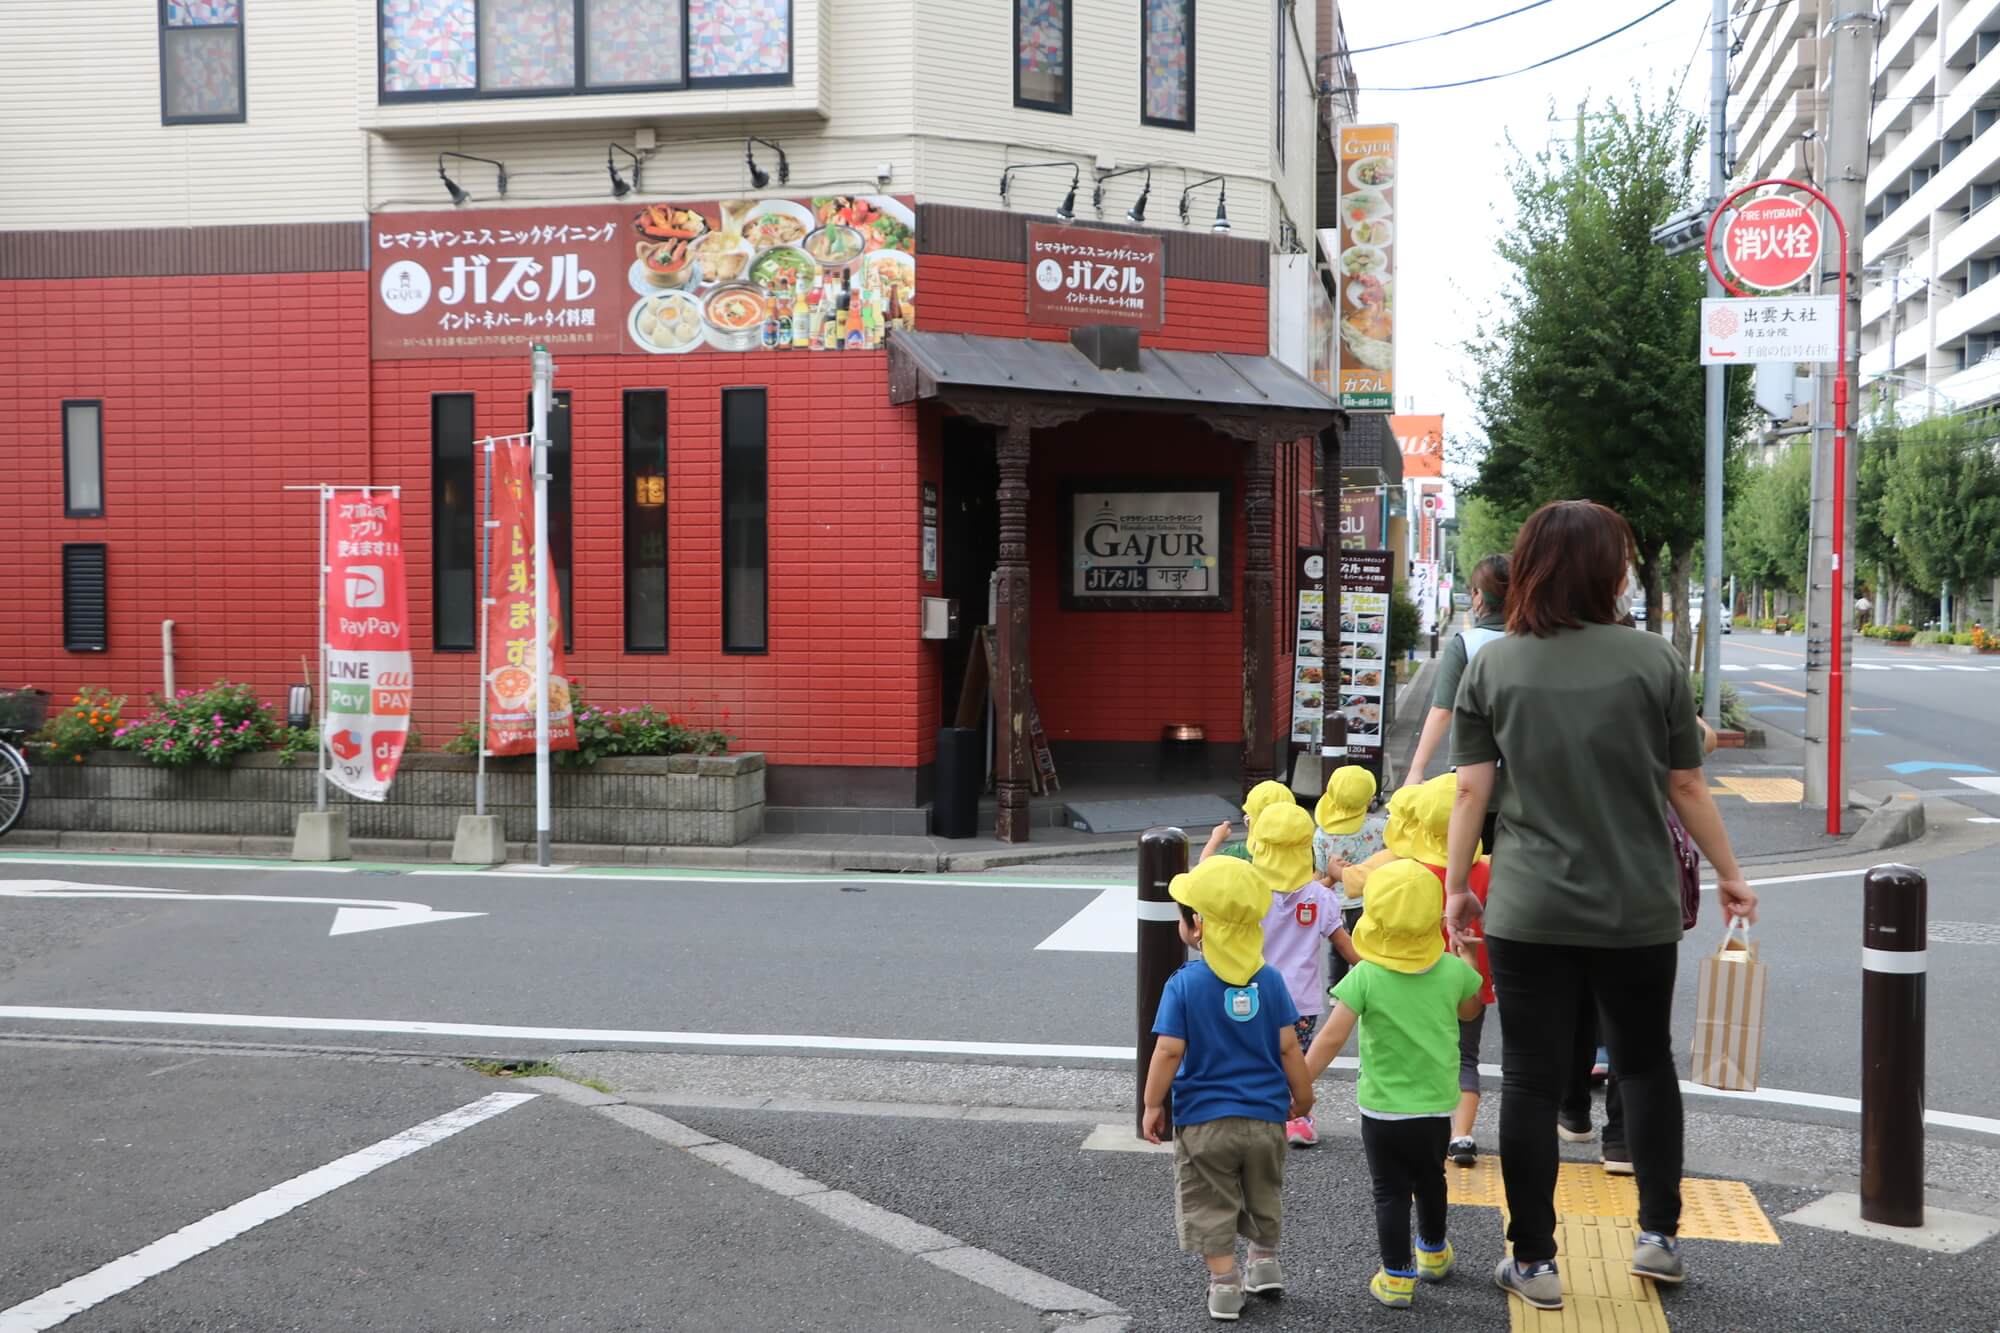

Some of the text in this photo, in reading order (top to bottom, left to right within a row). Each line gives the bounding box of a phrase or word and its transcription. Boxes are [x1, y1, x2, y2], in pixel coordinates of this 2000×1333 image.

[1741, 208, 1804, 221] FIRE HYDRANT
[379, 222, 617, 249] ヒマラヤンエスニックダイニング
[1734, 223, 1813, 261] 消火栓
[1035, 240, 1155, 264] ヒマラヤンエスニックダイニング
[438, 253, 597, 305] ガズル
[1066, 260, 1145, 294] ガズル
[438, 308, 596, 330] インド・ネパール・タイ料理
[1744, 307, 1817, 323] 出雲大社
[1084, 522, 1207, 564] GAJUR
[1087, 569, 1145, 588] ガズル
[340, 616, 400, 638] PayPay
[329, 661, 369, 680] LINE
[377, 671, 410, 687] au
[331, 689, 366, 711] Pay
